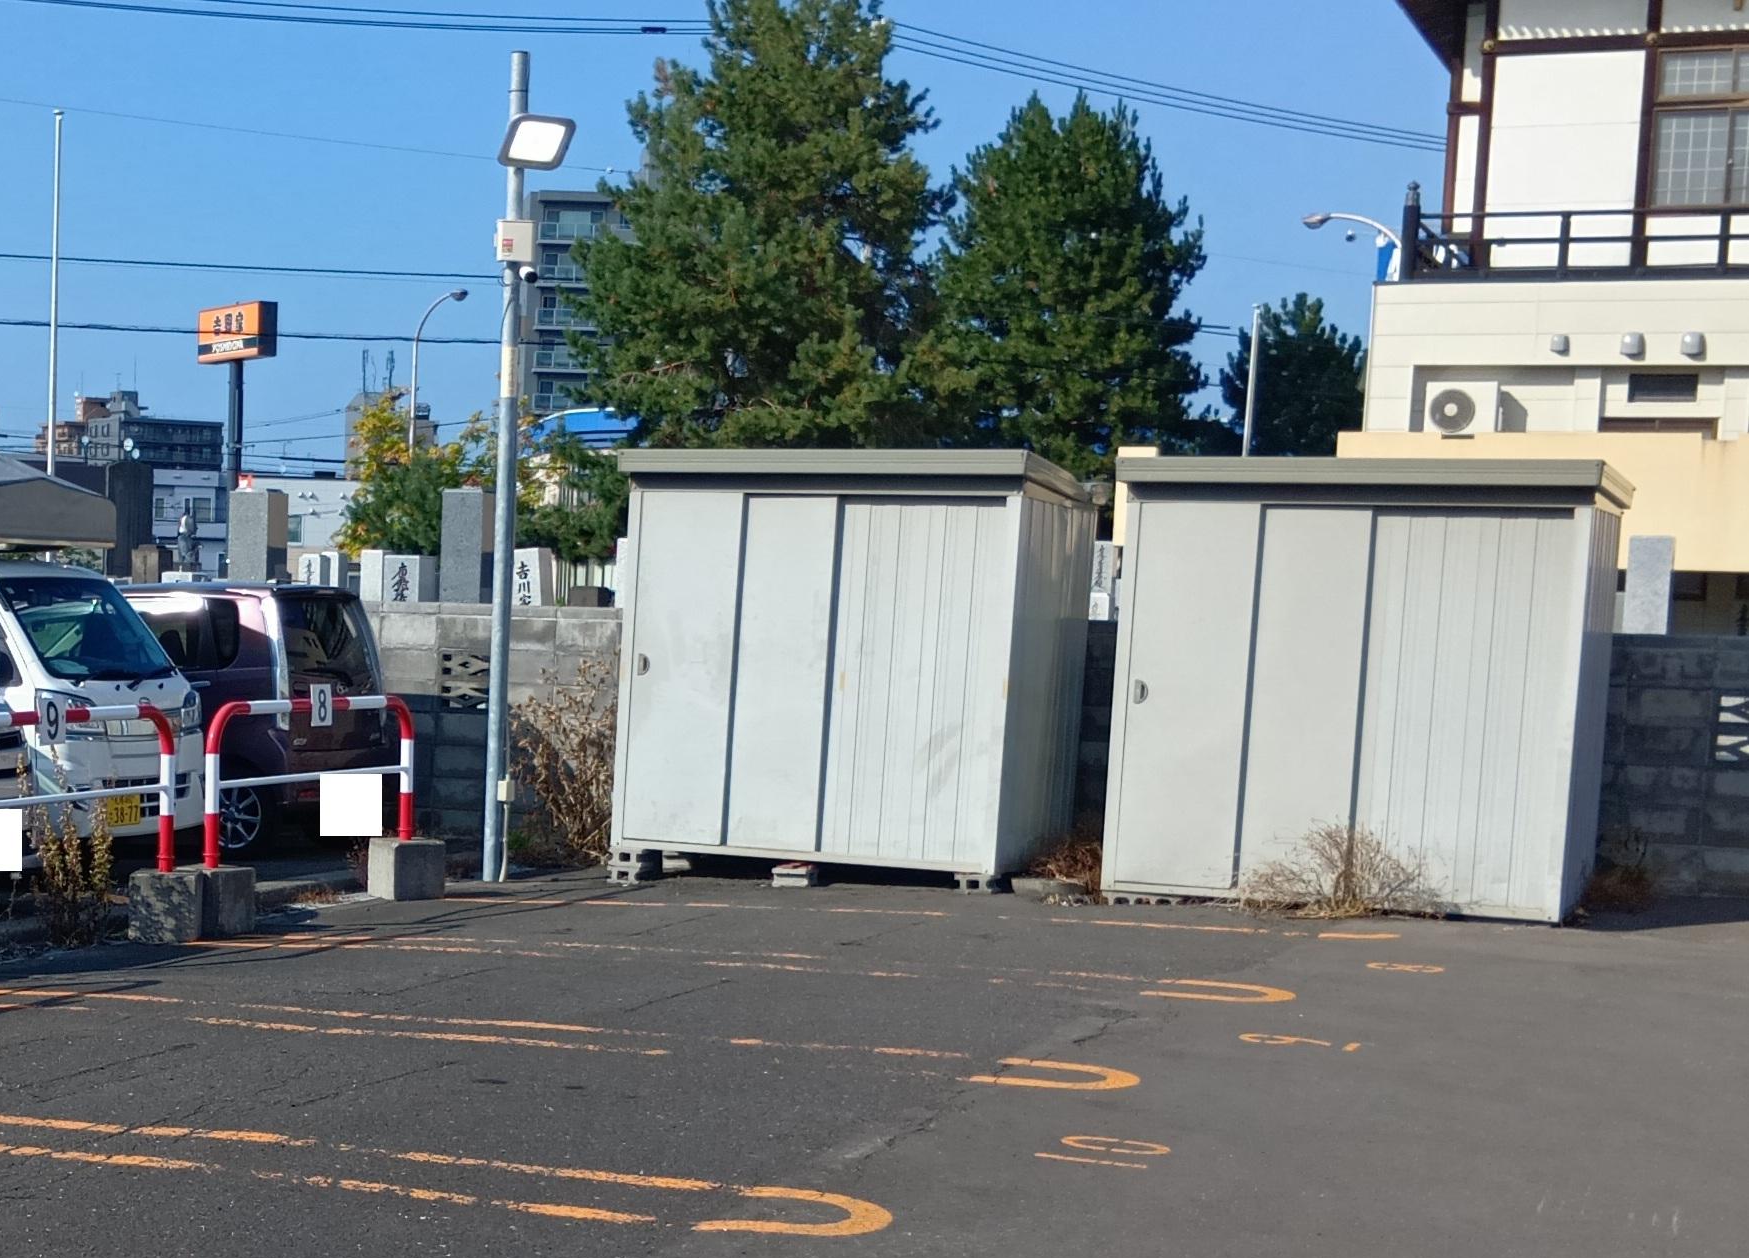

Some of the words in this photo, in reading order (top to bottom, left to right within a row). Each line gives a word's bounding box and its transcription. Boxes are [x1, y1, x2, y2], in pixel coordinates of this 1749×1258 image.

[46, 701, 59, 740] 9
[318, 689, 327, 722] 8
[1034, 1135, 1171, 1169] 10
